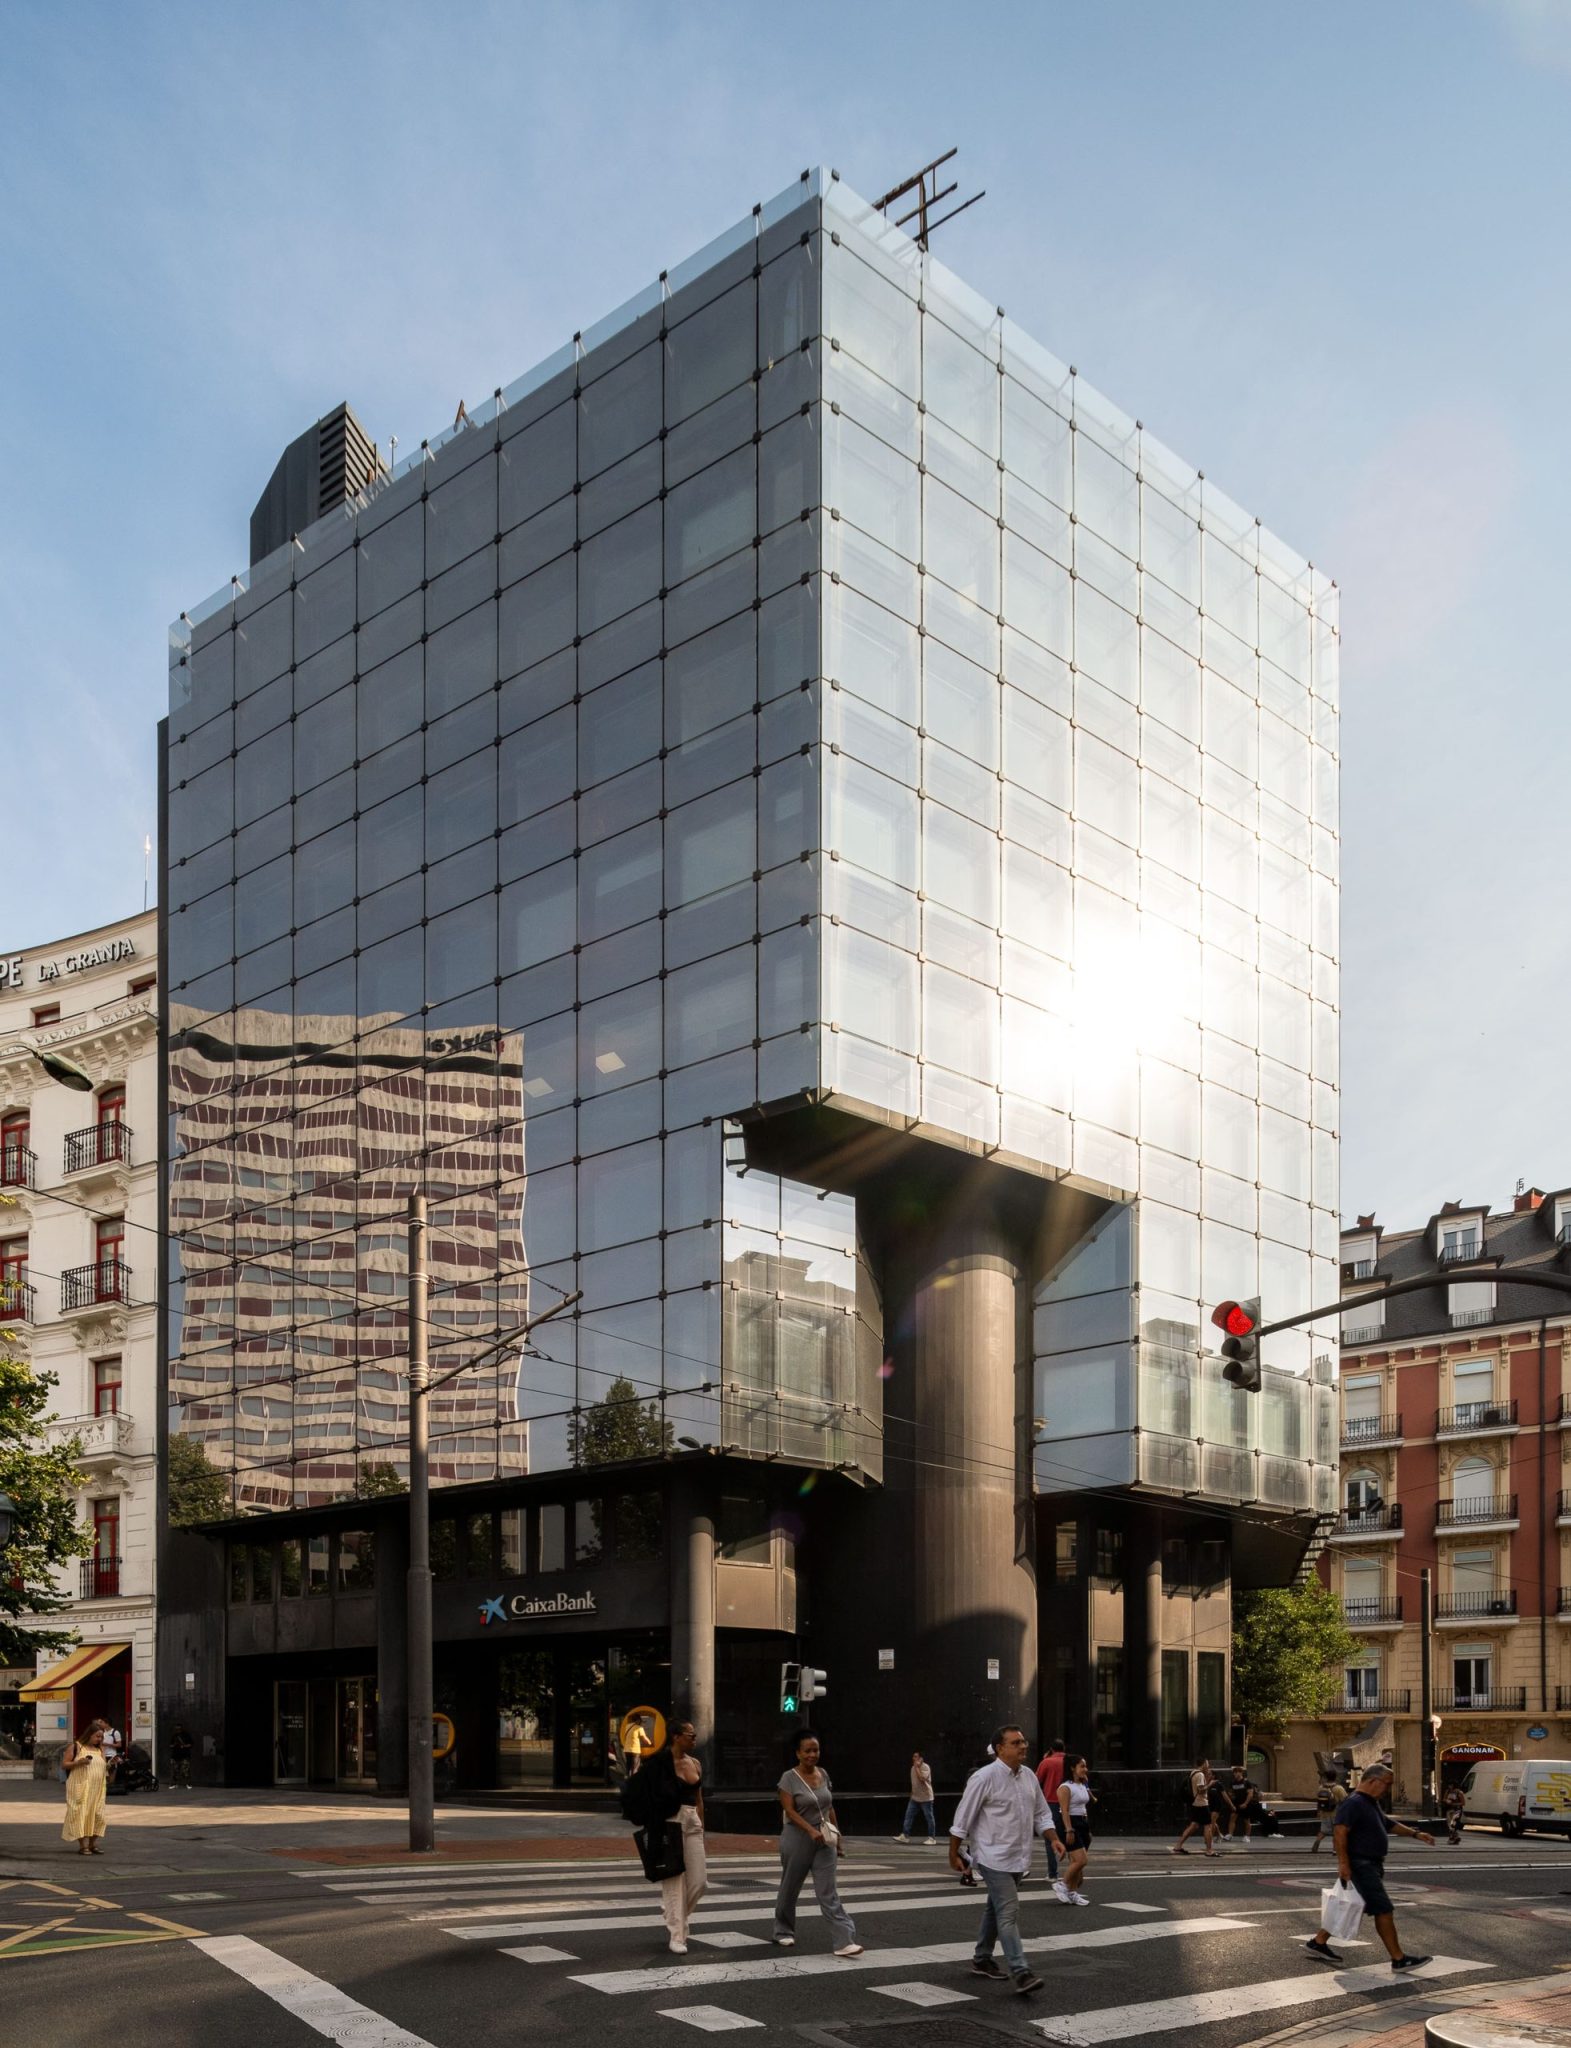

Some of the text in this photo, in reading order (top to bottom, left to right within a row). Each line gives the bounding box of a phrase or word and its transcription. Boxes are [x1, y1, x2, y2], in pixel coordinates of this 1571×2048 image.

[38, 961, 60, 982] LA
[64, 937, 135, 974] GRANJA
[511, 1590, 596, 1614] CaixaBank
[1502, 1784, 1518, 1792] Express
